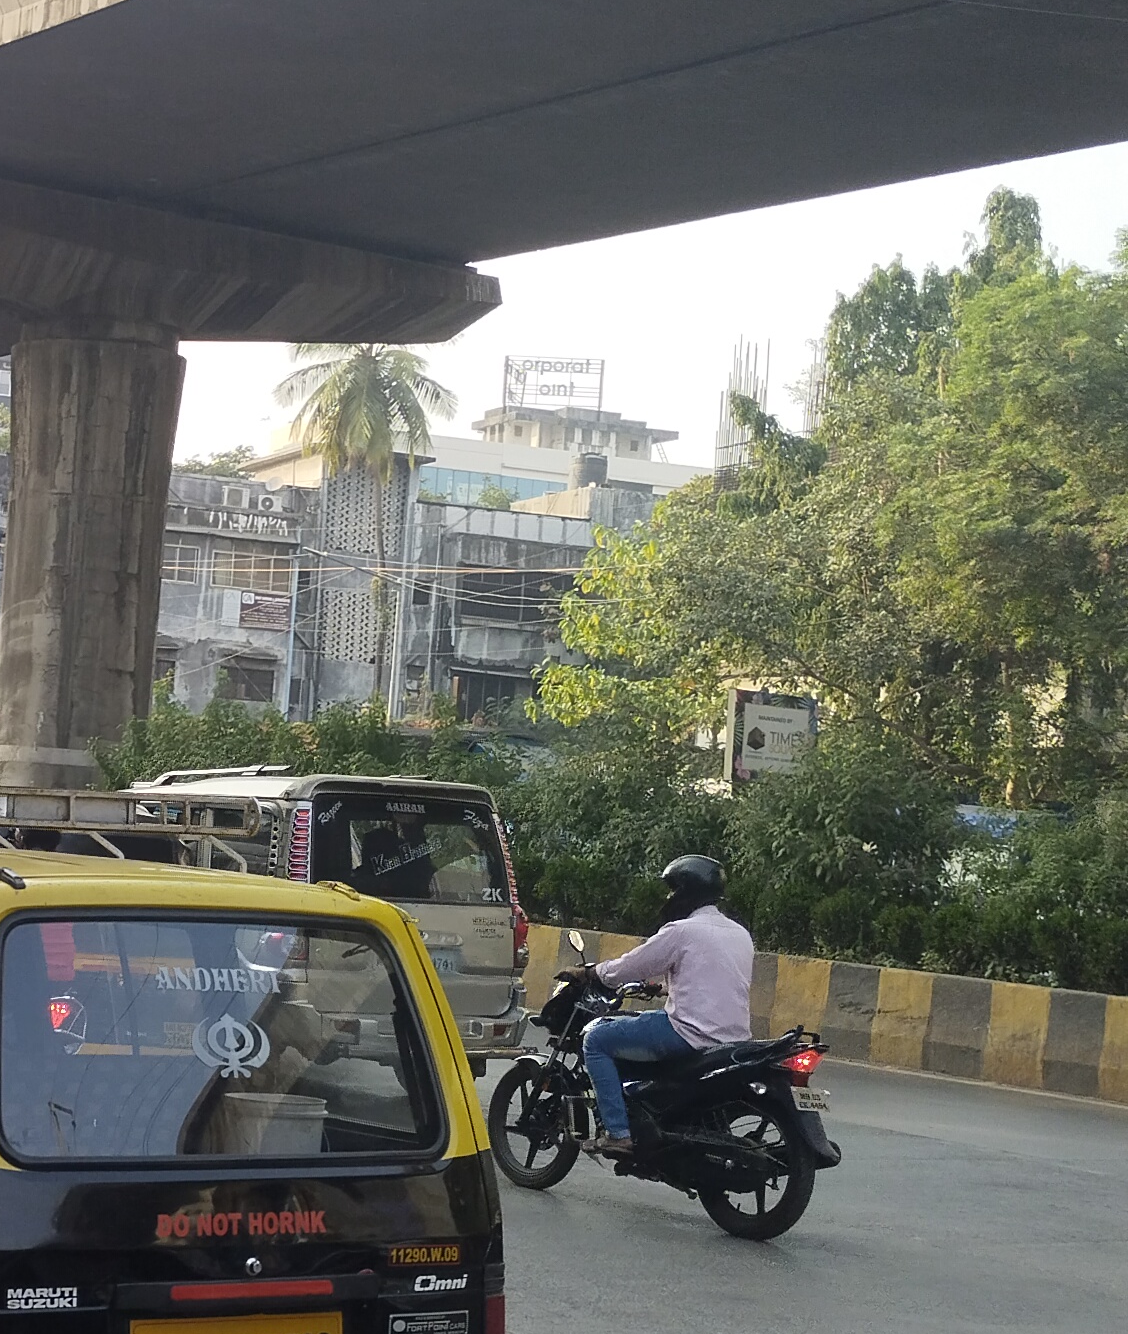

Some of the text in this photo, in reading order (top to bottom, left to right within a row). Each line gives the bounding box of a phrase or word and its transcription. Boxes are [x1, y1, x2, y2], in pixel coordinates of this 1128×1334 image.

[155, 967, 281, 993] ANDHERI
[156, 1210, 327, 1238] DO NOT HORNK
[390, 1246, 459, 1263] 11290.W.09
[414, 1274, 468, 1292] Omni
[7, 1287, 78, 1299] MARUTI
[7, 1297, 78, 1310] SUZUKI
